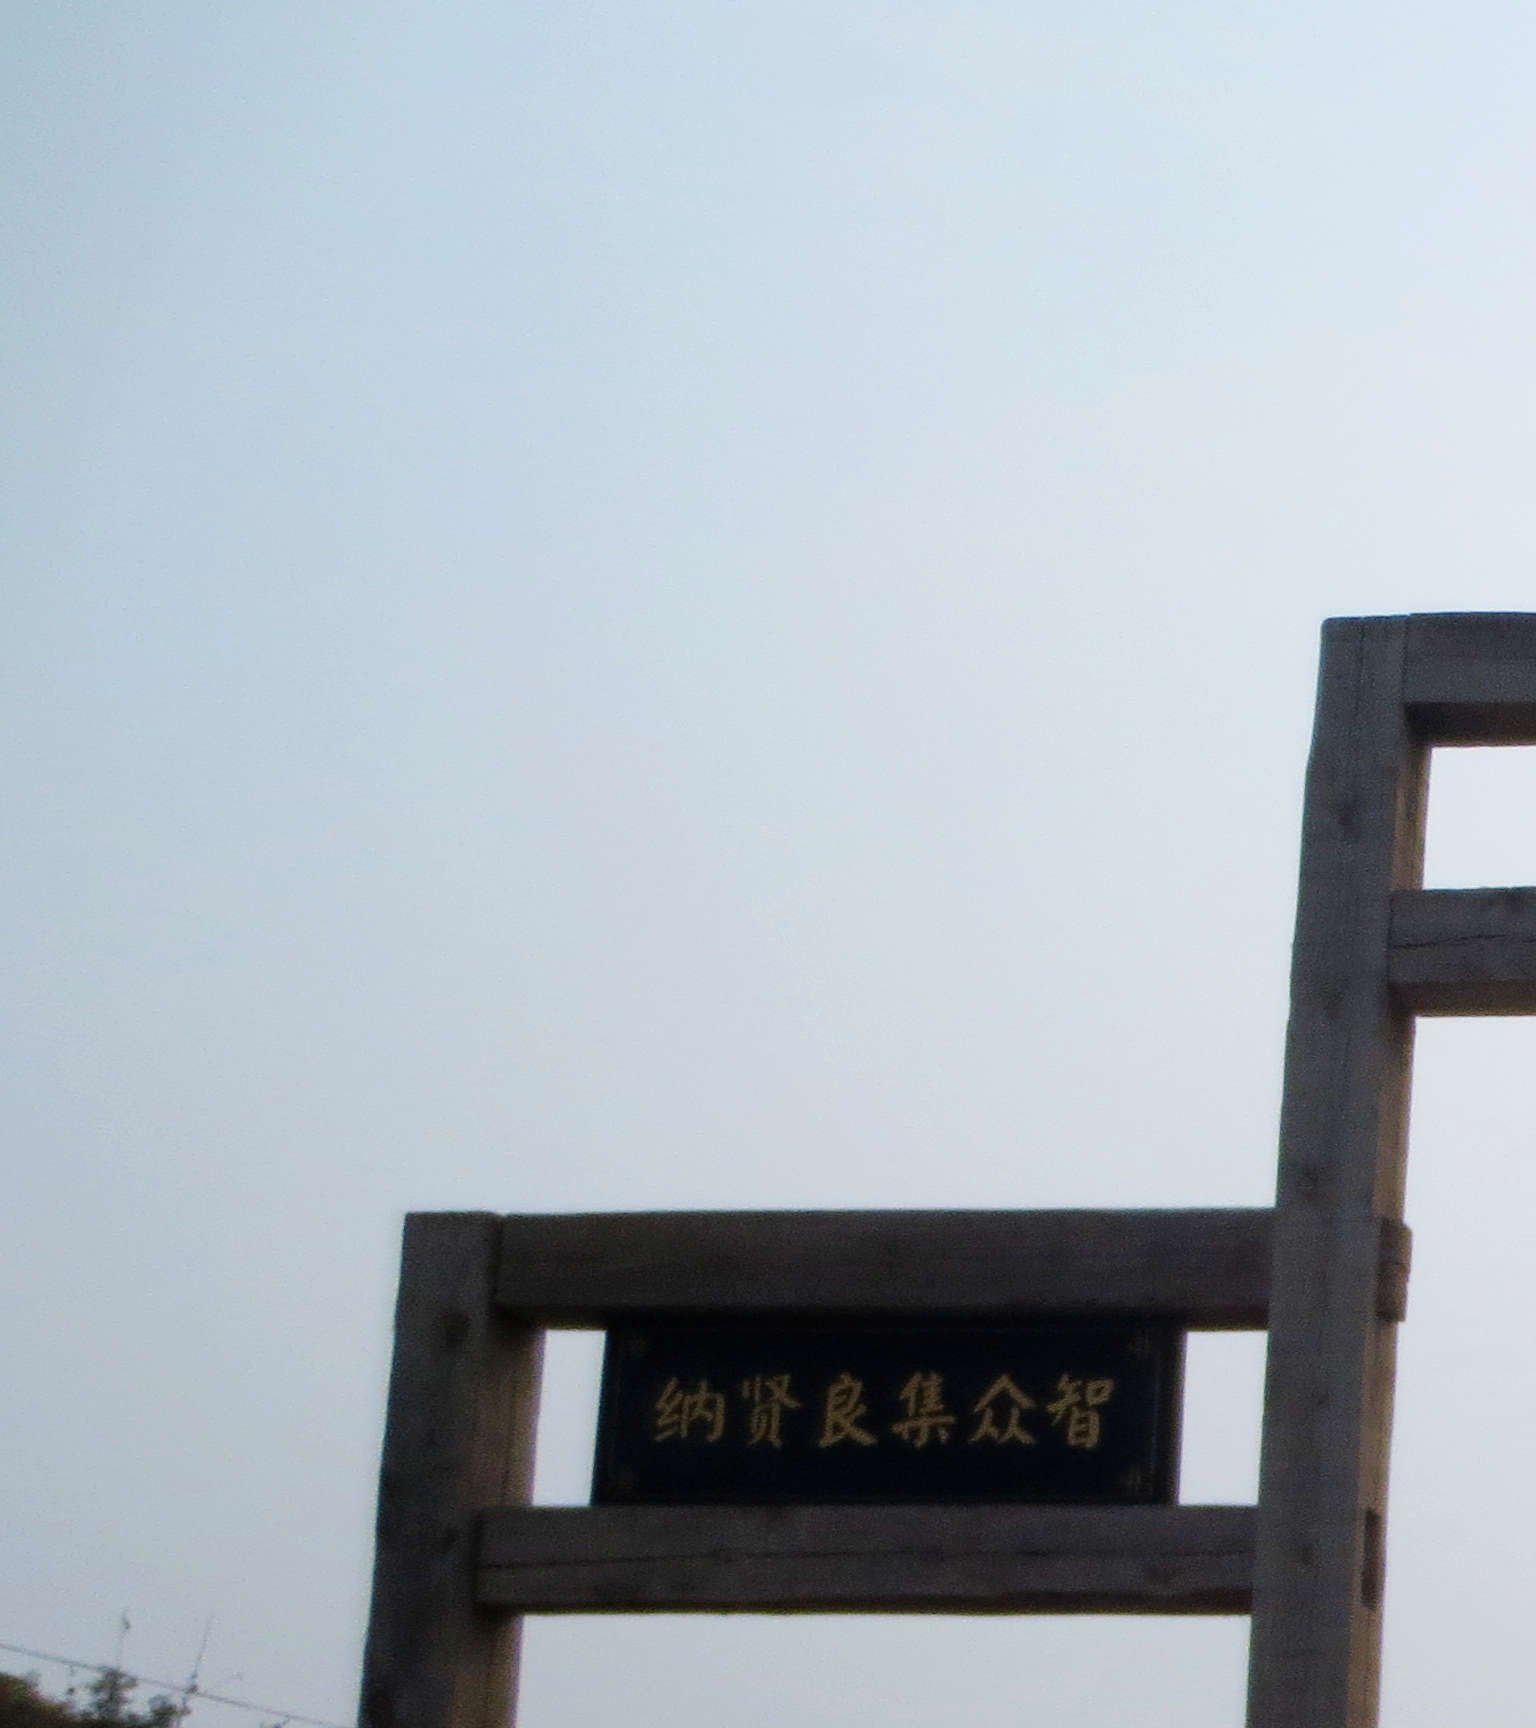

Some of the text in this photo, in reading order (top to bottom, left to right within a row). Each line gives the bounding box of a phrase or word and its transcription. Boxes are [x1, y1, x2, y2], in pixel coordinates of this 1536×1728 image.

[654, 1372, 1115, 1448] 纳贤良集众智
